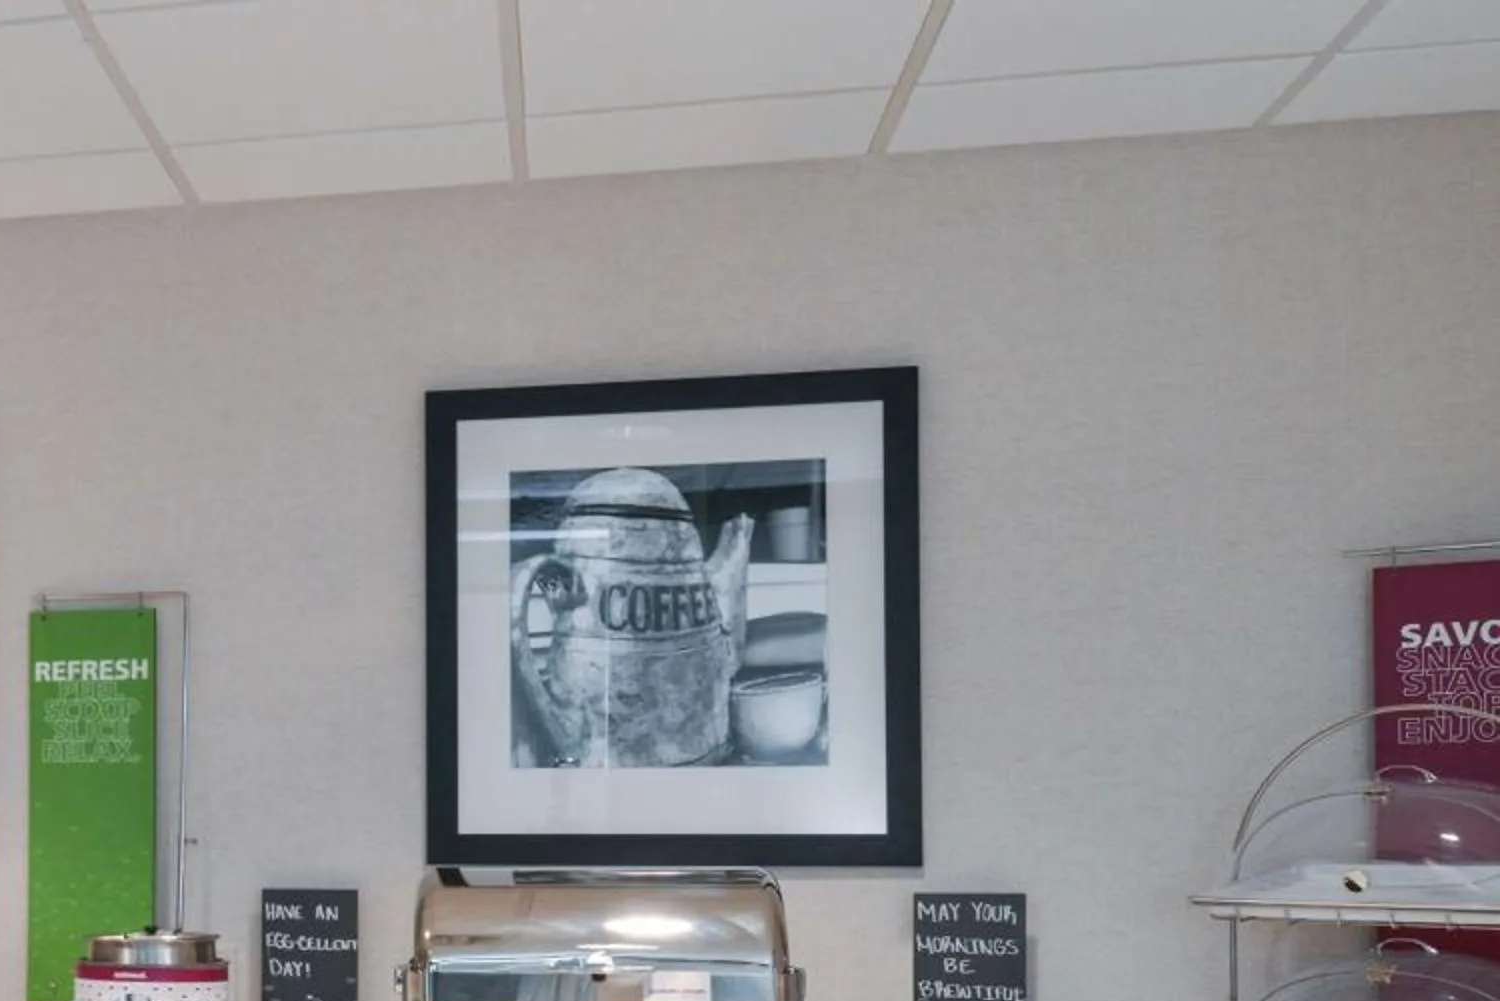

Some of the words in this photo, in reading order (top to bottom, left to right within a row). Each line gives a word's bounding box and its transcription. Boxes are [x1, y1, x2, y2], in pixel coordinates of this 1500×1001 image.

[599, 583, 717, 632] COFFEE
[35, 658, 148, 682] REFRESH
[43, 697, 141, 721] SCOOP
[265, 902, 304, 920] HAVE
[315, 904, 339, 920] AN
[917, 901, 960, 922] MAY
[971, 901, 1017, 925] YOUR
[916, 933, 1019, 956] MORNINGS
[269, 958, 311, 979] DAY!
[943, 957, 976, 975] BE
